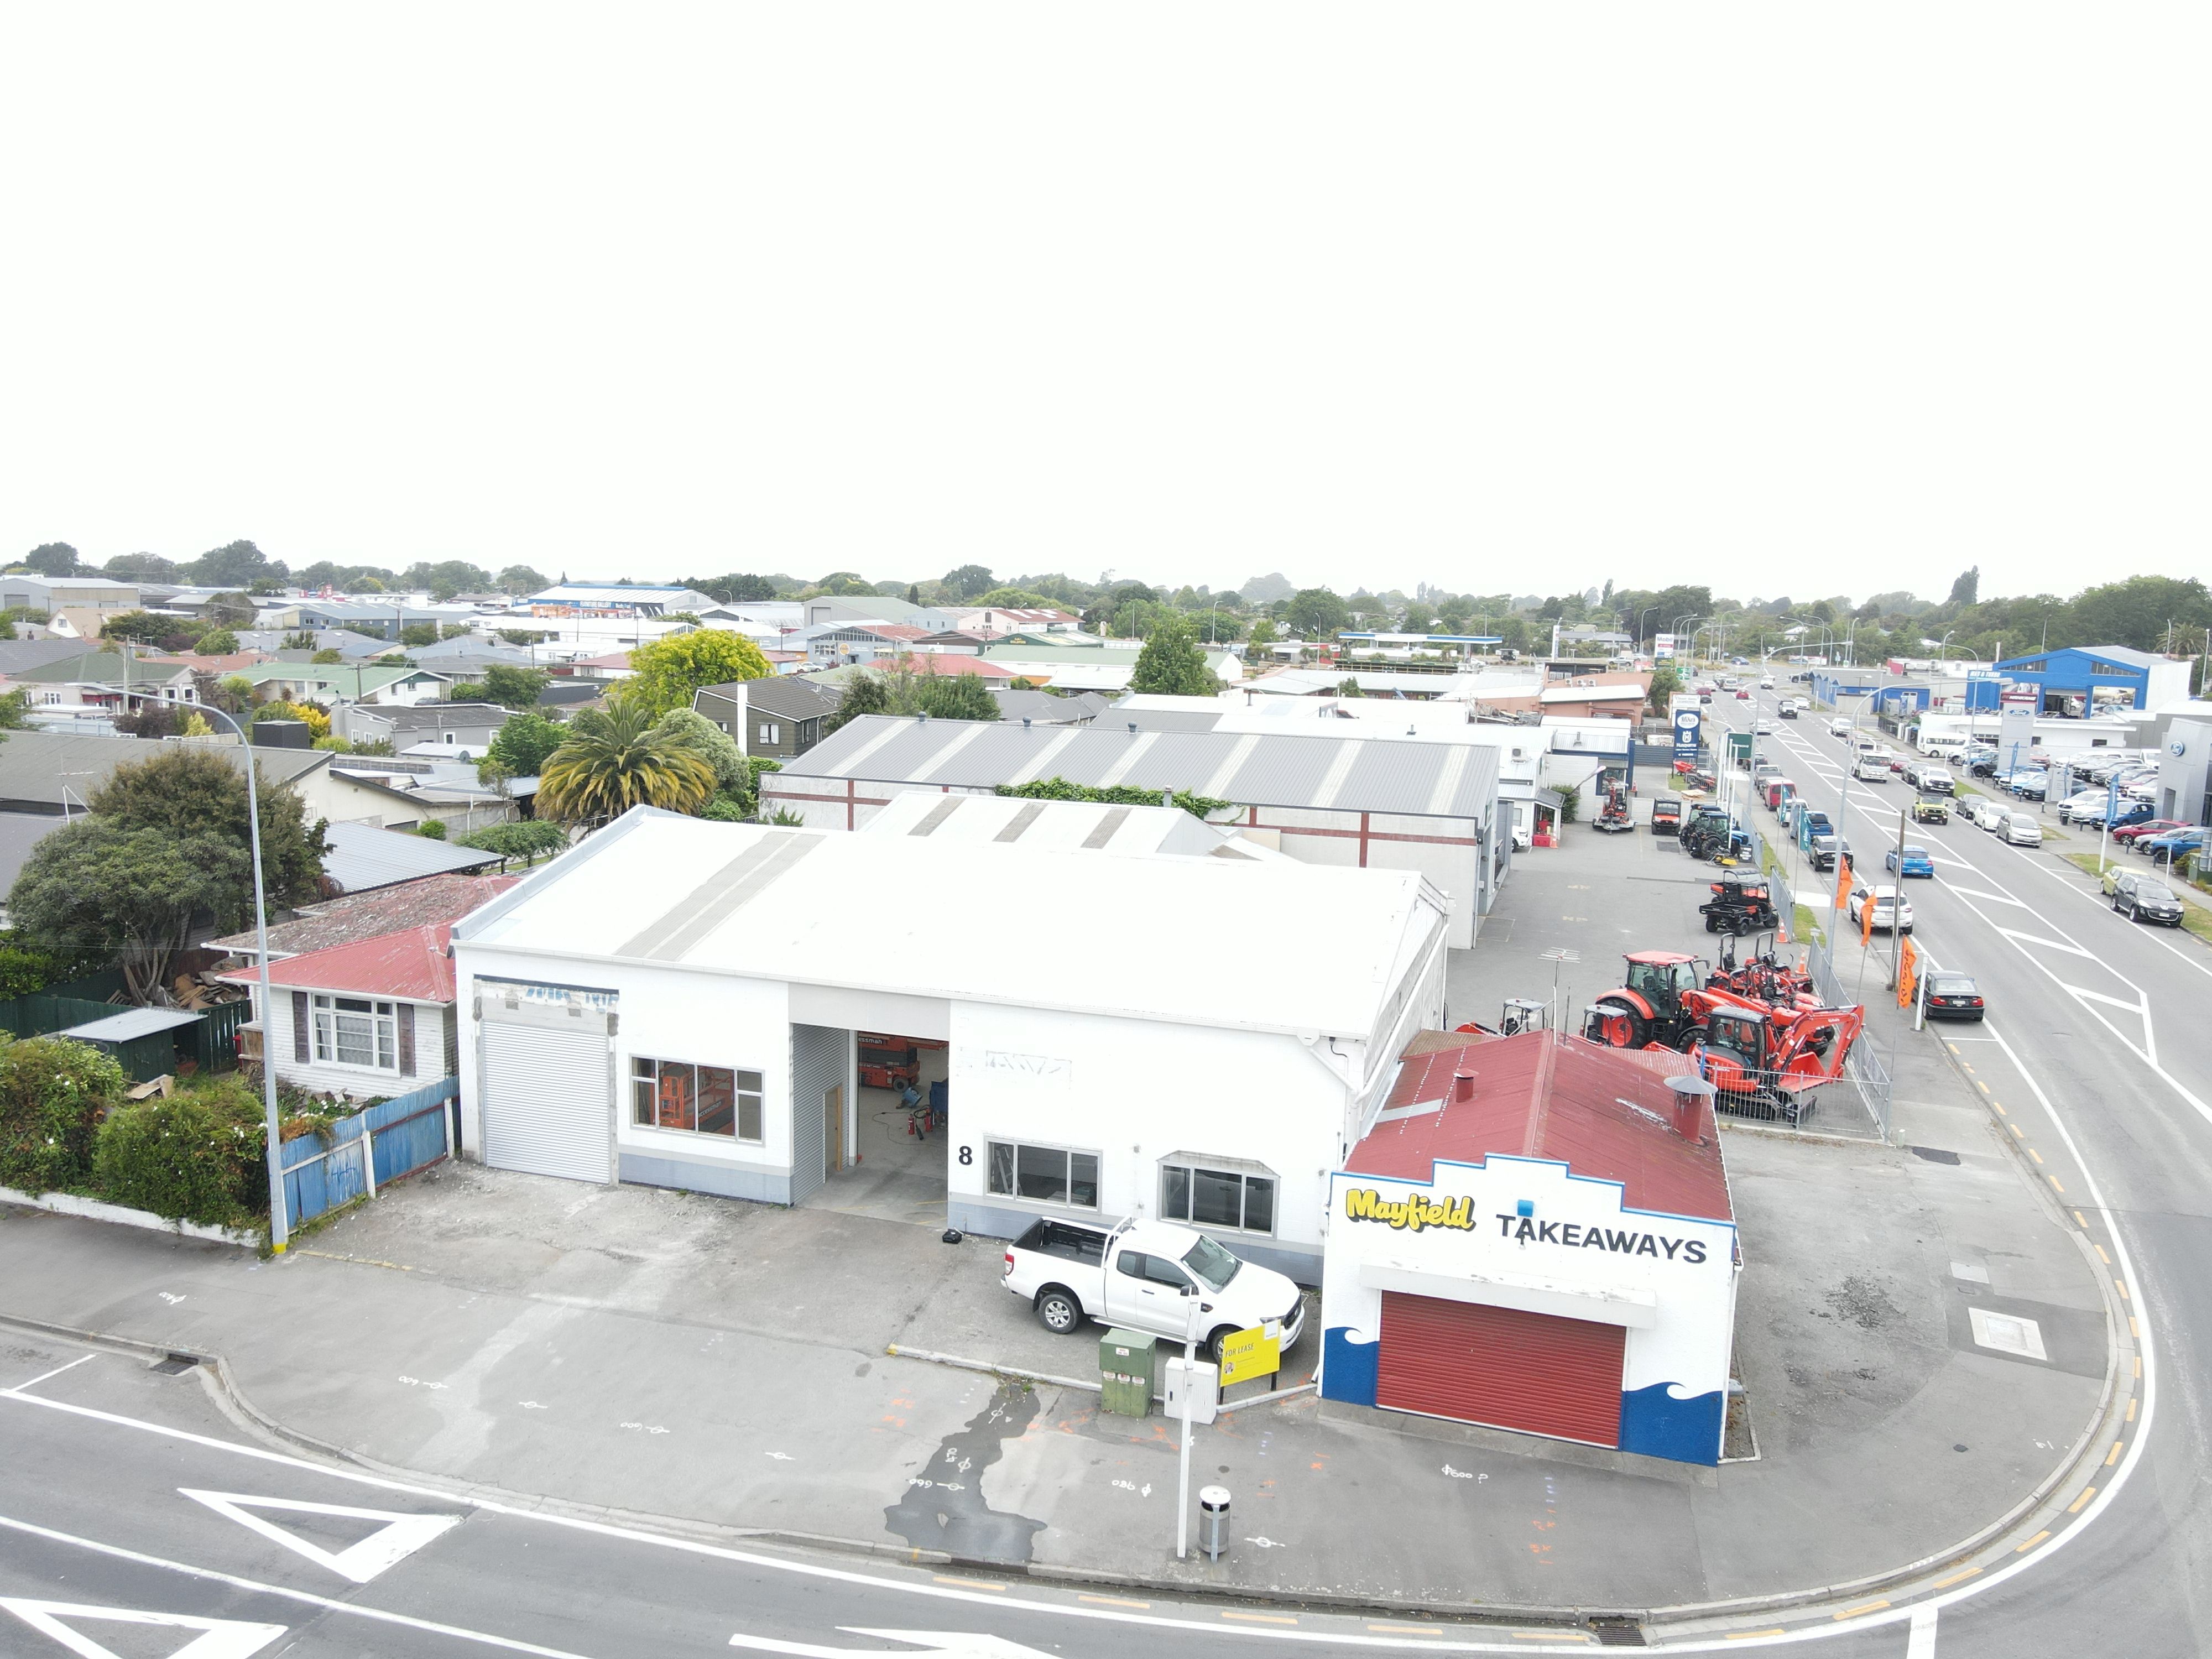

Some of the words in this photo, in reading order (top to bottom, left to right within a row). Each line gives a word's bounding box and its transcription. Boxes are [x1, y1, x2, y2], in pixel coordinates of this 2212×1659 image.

[959, 1145, 973, 1166] 8
[1346, 1189, 1477, 1232] Mayfield
[1496, 1214, 1707, 1264] TAKEAWAYS
[1225, 1348, 1237, 1358] FOR
[1238, 1342, 1255, 1354] LEASE
